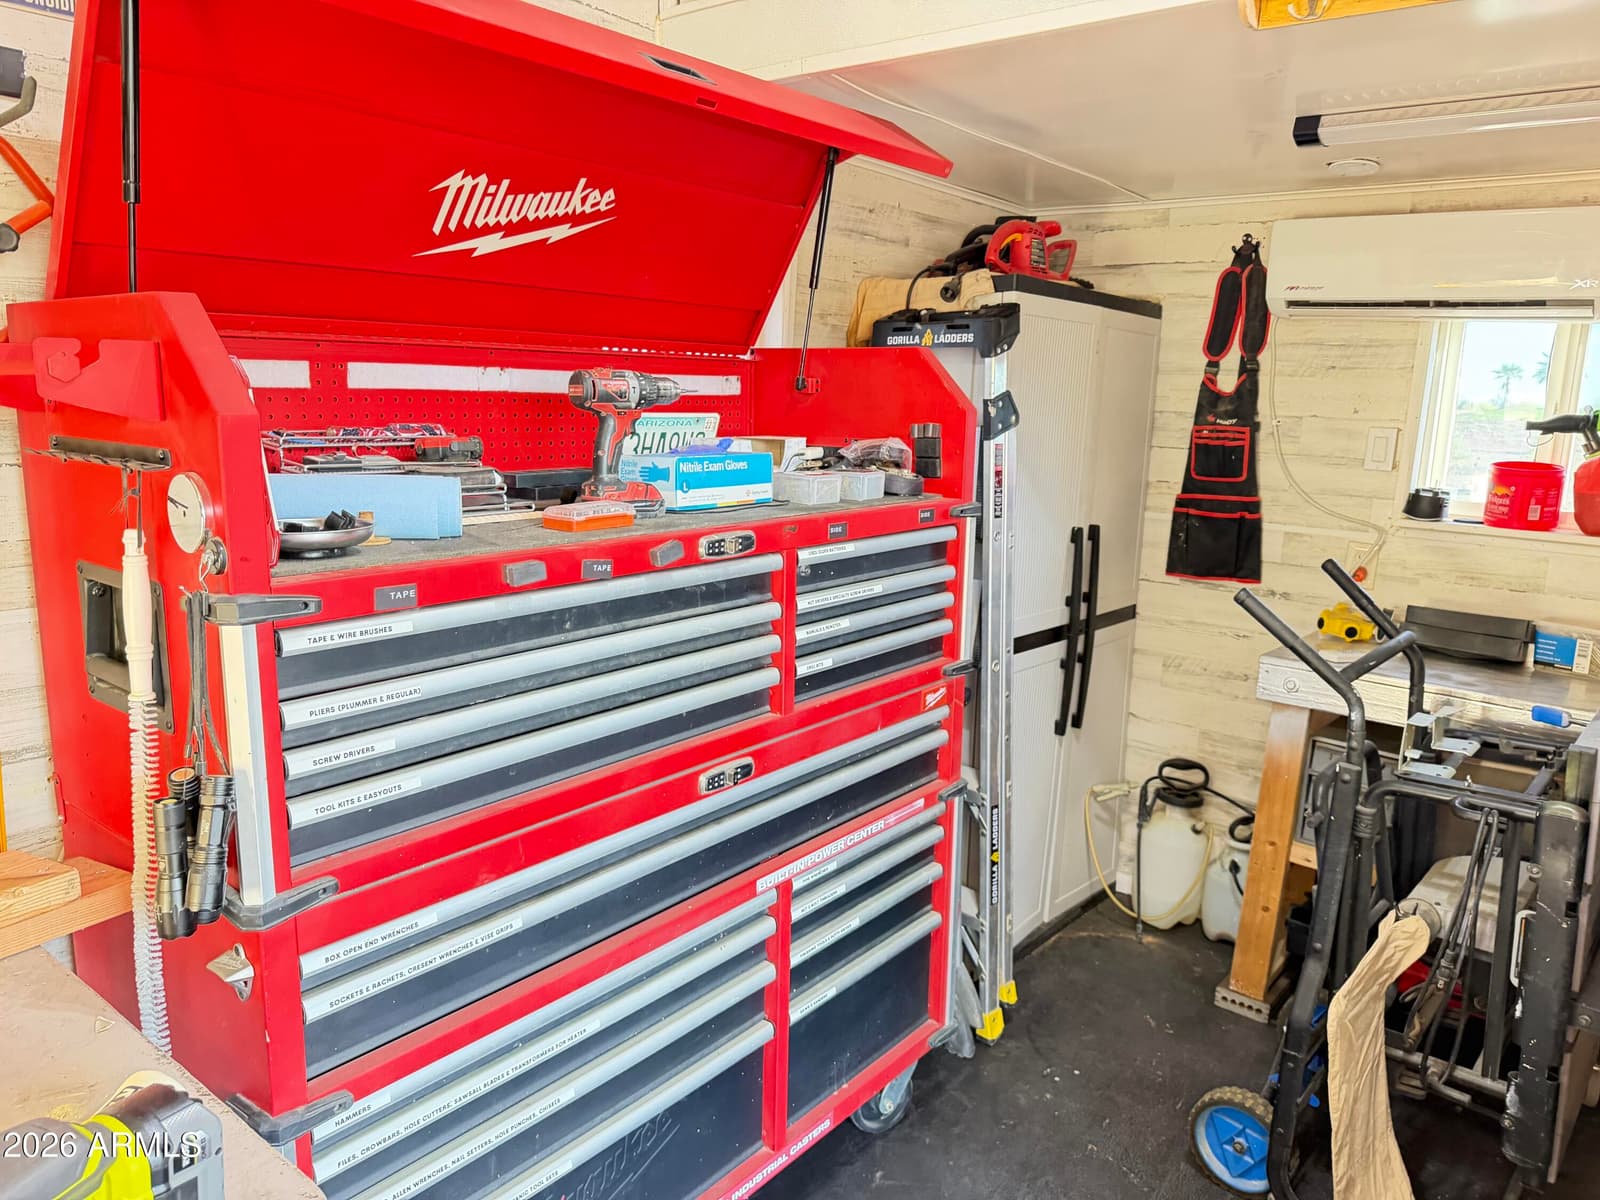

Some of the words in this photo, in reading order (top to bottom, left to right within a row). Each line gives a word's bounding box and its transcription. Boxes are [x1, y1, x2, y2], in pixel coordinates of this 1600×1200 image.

[428, 168, 616, 236] Milwaukee
[887, 335, 920, 345] GORILLA
[934, 333, 974, 344] LADDERS
[637, 419, 692, 427] ARIZONA
[679, 460, 703, 473] Nitrile
[704, 460, 724, 472] Exam
[725, 459, 748, 470] Gloves
[683, 482, 688, 491] L
[593, 564, 612, 572] TAPE
[389, 589, 416, 600] TAPE
[308, 636, 327, 645] TAPE
[338, 631, 357, 640] WIRE
[359, 625, 393, 636] BRUSHES
[309, 707, 335, 717] PLIERS
[337, 697, 378, 712] (PLUMMER
[386, 687, 422, 701] REGULAR)
[312, 754, 341, 767] SCREW
[343, 745, 376, 759] DRIVERS
[314, 803, 336, 815] TOOL
[338, 797, 356, 809] KITS
[363, 784, 402, 802] EASYOUTS
[807, 840, 845, 867] POWER
[846, 819, 885, 845] CENTER
[325, 950, 341, 963] BOX
[343, 943, 363, 958] OPEN
[364, 938, 379, 950] END
[380, 920, 420, 941] WRENCHES
[329, 988, 364, 1009] SOCKETS
[372, 971, 407, 991] RACHETS,
[407, 956, 437, 975] CRESENT
[439, 941, 474, 961] WRENCHES
[481, 932, 495, 944] VISE
[496, 922, 514, 937] GRIPS
[337, 1154, 359, 1169] FILES,
[360, 1129, 403, 1156] CROWBARS,
[404, 1117, 421, 1132] HOLE
[453, 1086, 482, 1105] SAWSALL
[483, 1072, 505, 1089] BLADES
[511, 1046, 555, 1077] TRANSFORMERS
[555, 1039, 567, 1050] FOR
[567, 1028, 587, 1045] HEATER
[334, 1104, 372, 1128] HAMMERS
[392, 1185, 411, 1200] ALLEN
[451, 1154, 465, 1167] NAIL
[494, 1127, 509, 1140] HOLE
[538, 1097, 561, 1115] CHISELS
[731, 1152, 788, 1200] INDUSTRIAL
[789, 1118, 831, 1156] CASTERS
[530, 1178, 544, 1192] TOOL
